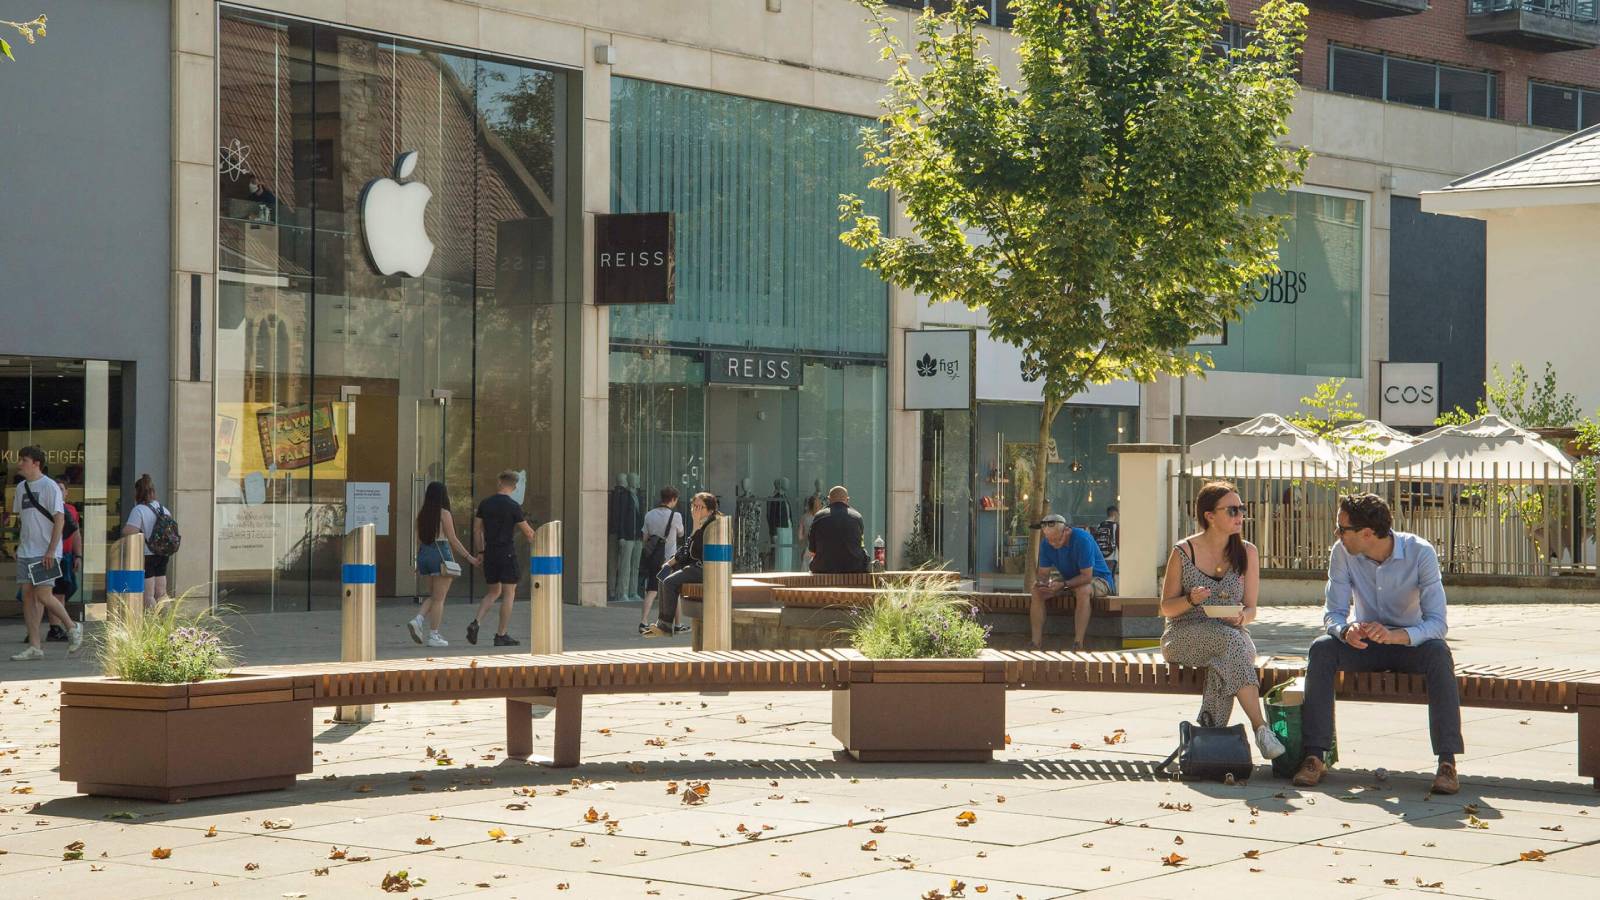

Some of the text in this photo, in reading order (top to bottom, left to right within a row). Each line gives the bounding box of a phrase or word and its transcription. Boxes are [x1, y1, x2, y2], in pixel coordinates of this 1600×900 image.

[600, 251, 664, 268] REISS
[1246, 271, 1307, 304] OBBS
[728, 357, 790, 379] REISS
[1384, 385, 1434, 404] COS
[1, 450, 19, 464] KU
